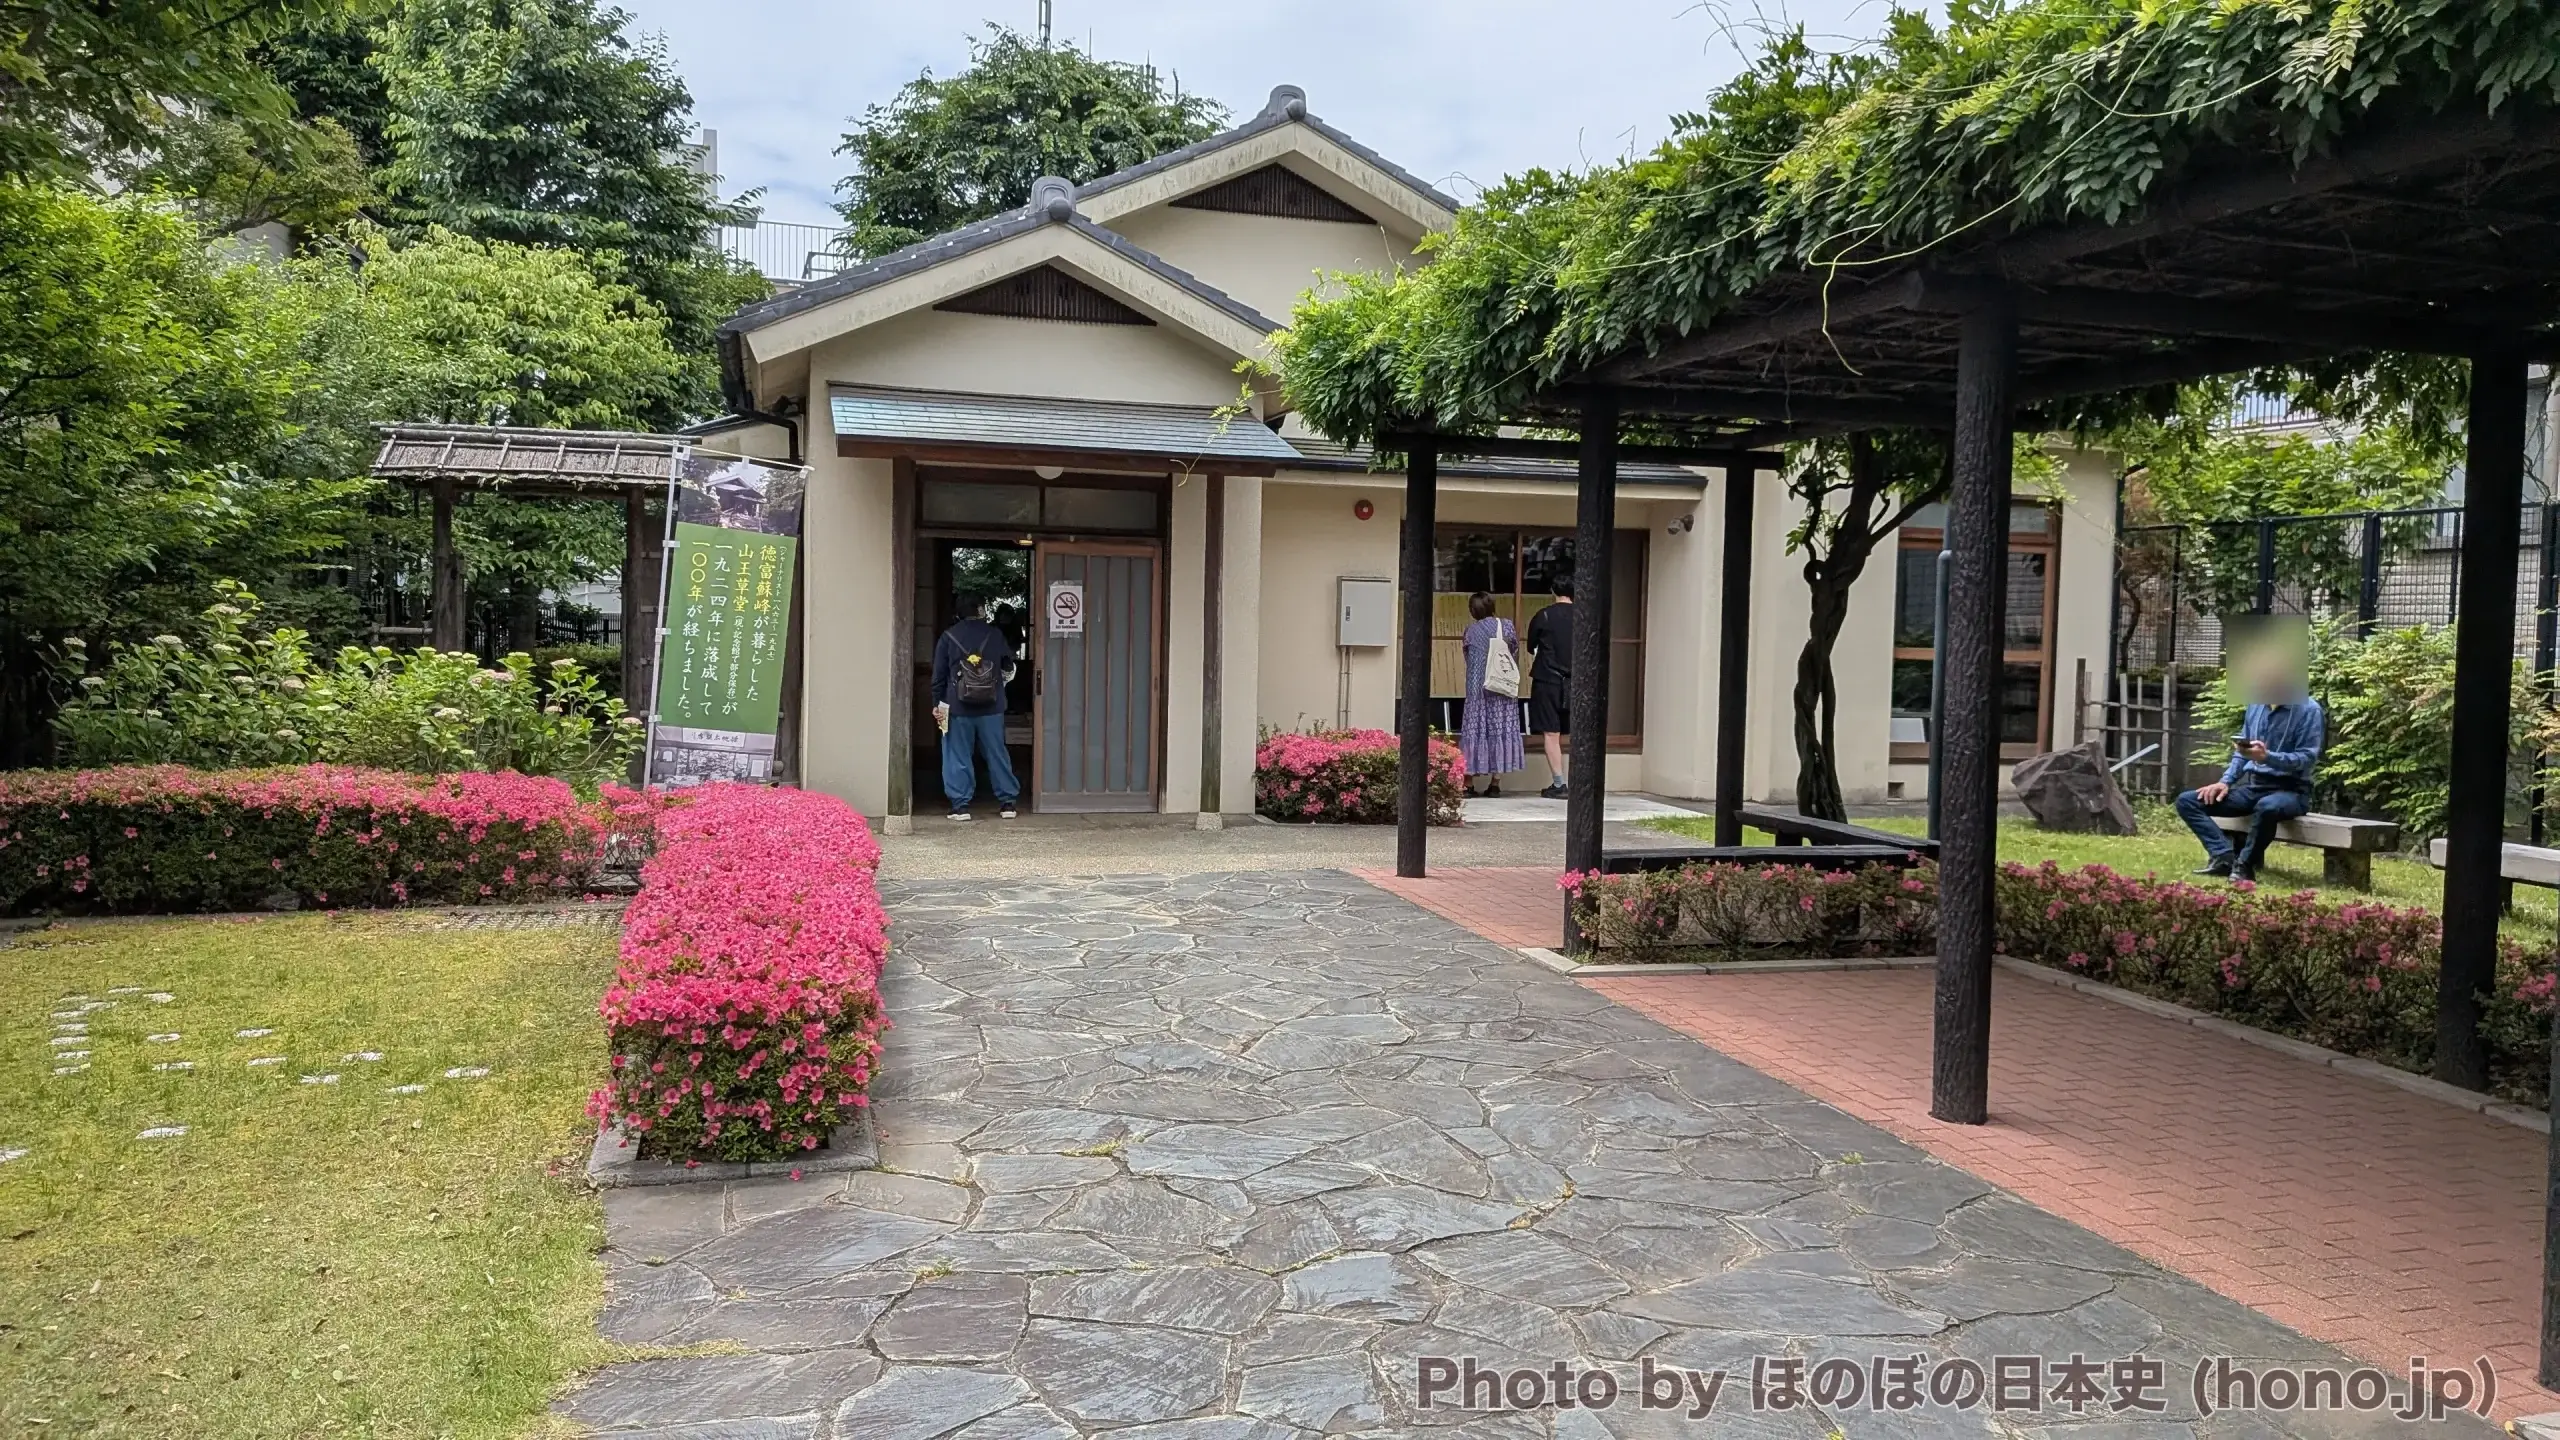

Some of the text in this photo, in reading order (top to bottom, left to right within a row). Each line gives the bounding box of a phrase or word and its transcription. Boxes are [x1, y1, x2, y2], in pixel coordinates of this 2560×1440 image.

[700, 545, 733, 716] 一九二四年に落成して
[747, 545, 777, 701] 徳富蘇峰が暮らした
